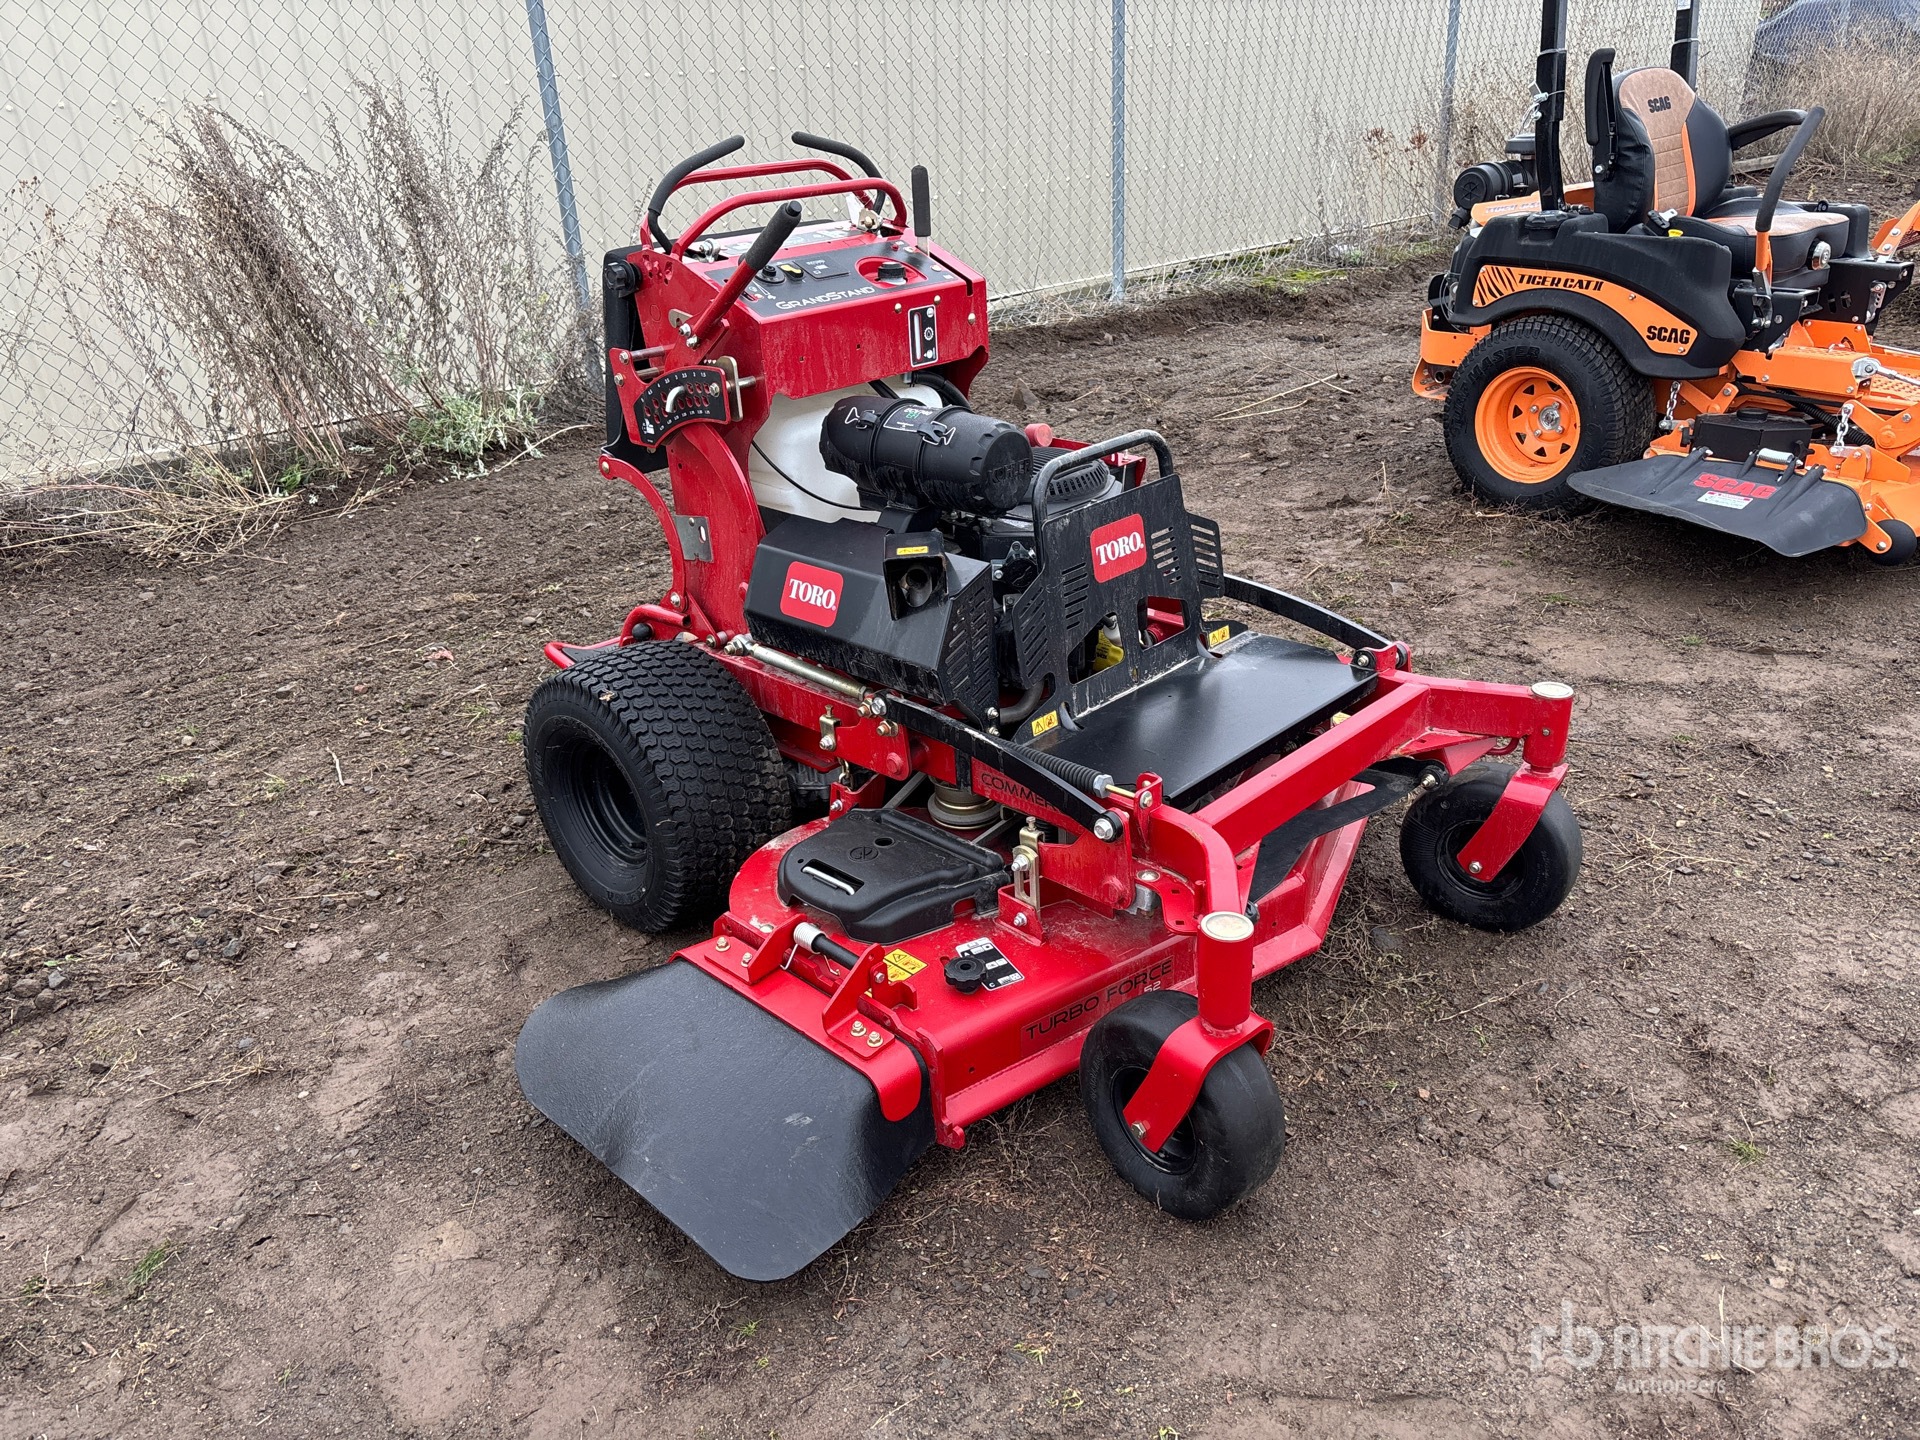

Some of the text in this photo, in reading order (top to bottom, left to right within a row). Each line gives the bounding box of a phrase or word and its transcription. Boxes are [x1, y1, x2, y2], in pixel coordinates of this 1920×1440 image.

[1648, 95, 1671, 113] SCAG
[1518, 273, 1562, 287] TIGER
[1563, 278, 1594, 290] CAT
[1646, 325, 1690, 345] SCAG
[1693, 473, 1777, 499] SCAG
[1025, 959, 1172, 1039] TURBO FORCE
